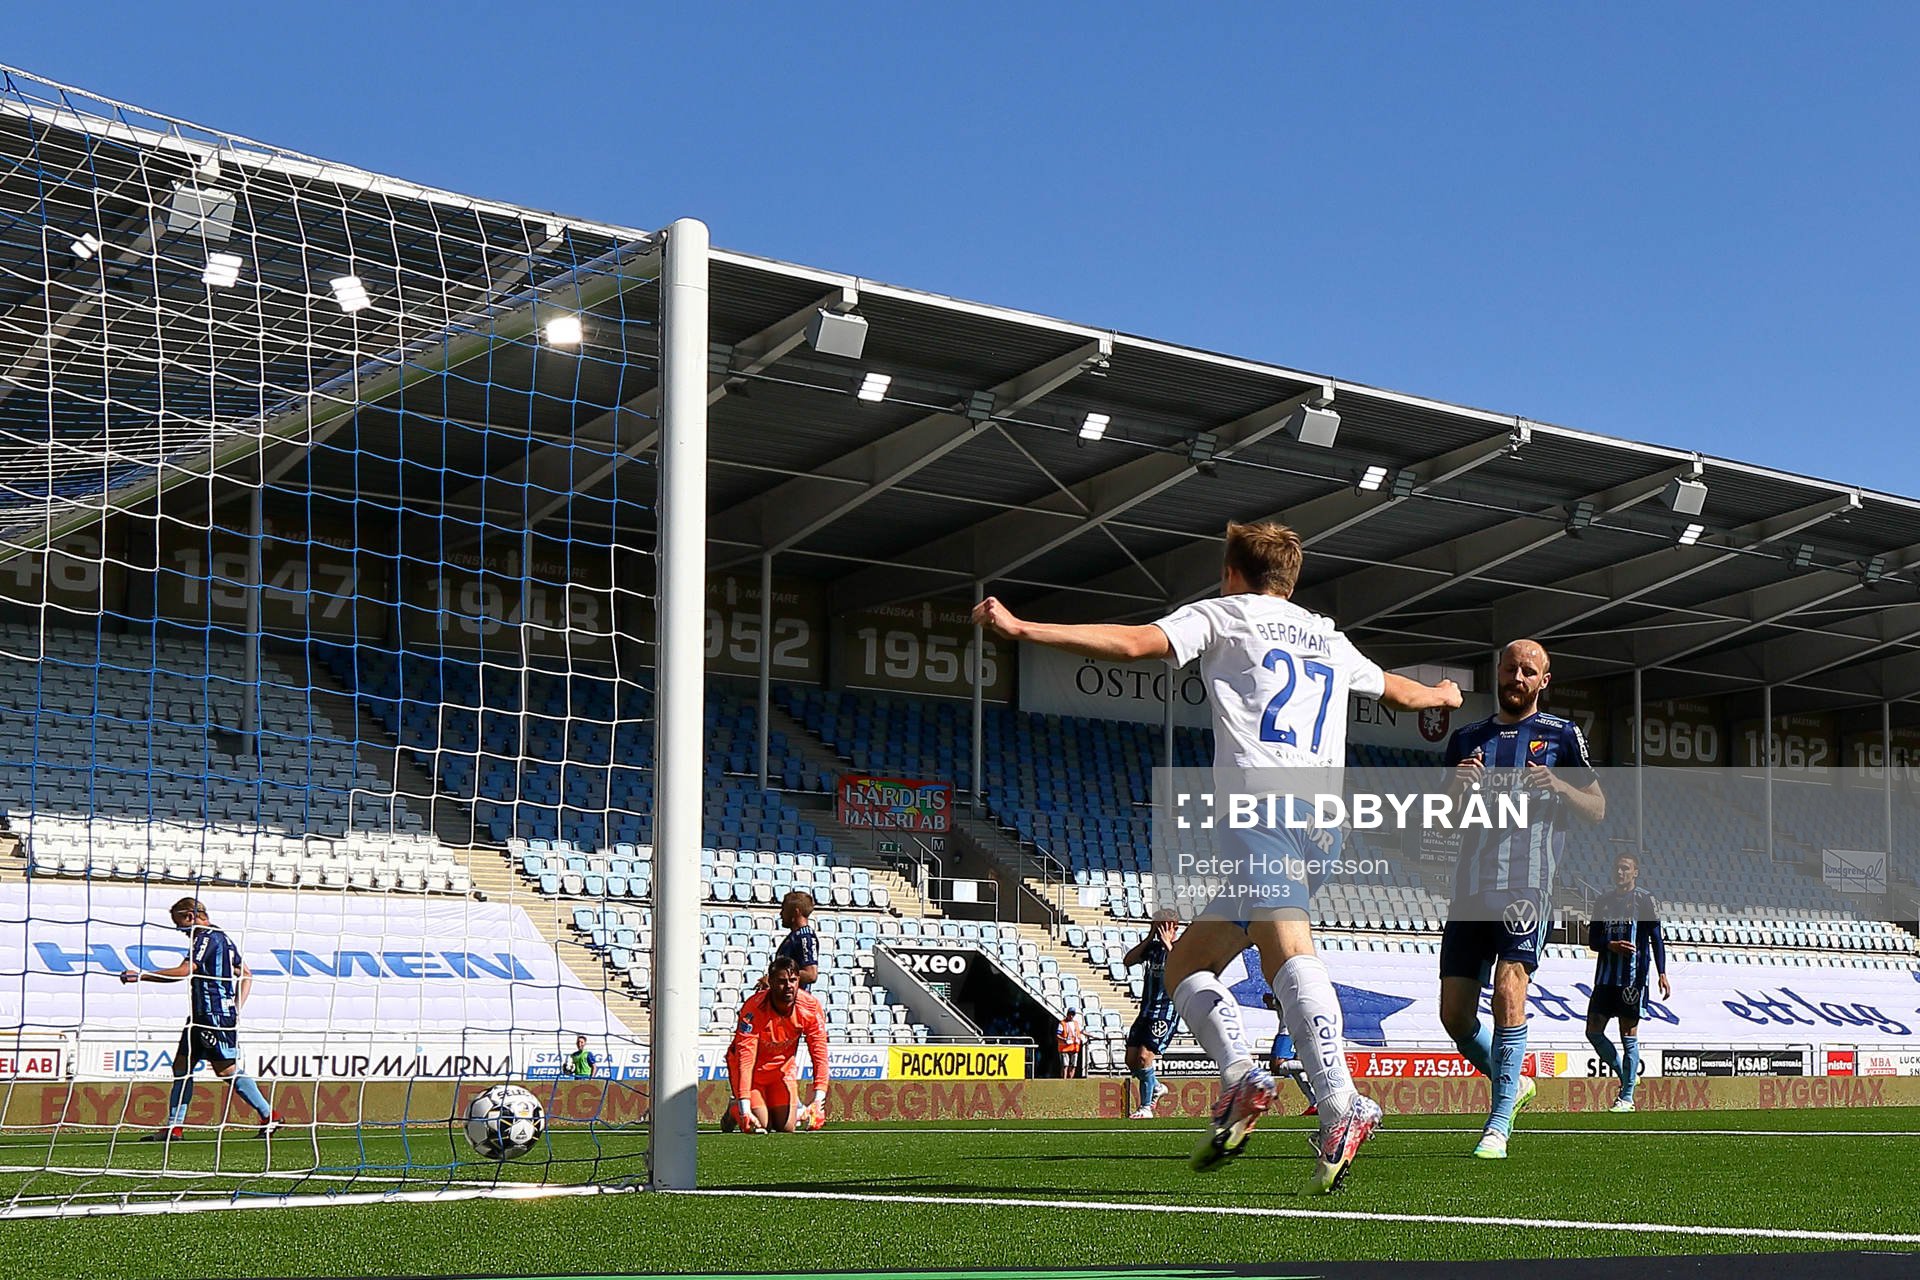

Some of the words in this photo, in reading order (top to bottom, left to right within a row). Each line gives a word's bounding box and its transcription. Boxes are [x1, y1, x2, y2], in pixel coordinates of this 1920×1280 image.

[174, 548, 361, 618] 1947
[427, 577, 599, 645] 1948
[1256, 622, 1332, 657] BERGMAN
[857, 626, 998, 687] 1956
[1260, 648, 1334, 755] 27
[1625, 717, 1719, 763] 1960
[1744, 730, 1829, 774] 1962
[845, 780, 946, 810] HÅRDHS
[844, 804, 915, 829] MÅLERI
[919, 814, 946, 831] AB
[1722, 989, 1816, 1026] ett
[1774, 987, 1913, 1036] lag
[26, 1058, 53, 1073] AB
[535, 1052, 614, 1063] STÅTGA
[828, 1052, 878, 1064] ÅTHÖGA
[901, 1052, 1009, 1077] PACKOPLOCK
[1152, 1060, 1219, 1071] HYDROSCA
[1365, 1053, 1410, 1077] ÅBY
[1414, 1058, 1476, 1078] FASAD
[1664, 1056, 1698, 1071] KSAB
[1737, 1057, 1769, 1071] KSAB
[1870, 1057, 1892, 1067] MBA
[807, 1068, 860, 1078] VKSTAD
[862, 1068, 877, 1078] AB
[1357, 1080, 1491, 1113] YGGMA
[1758, 1077, 1884, 1107] BYGGMAX
